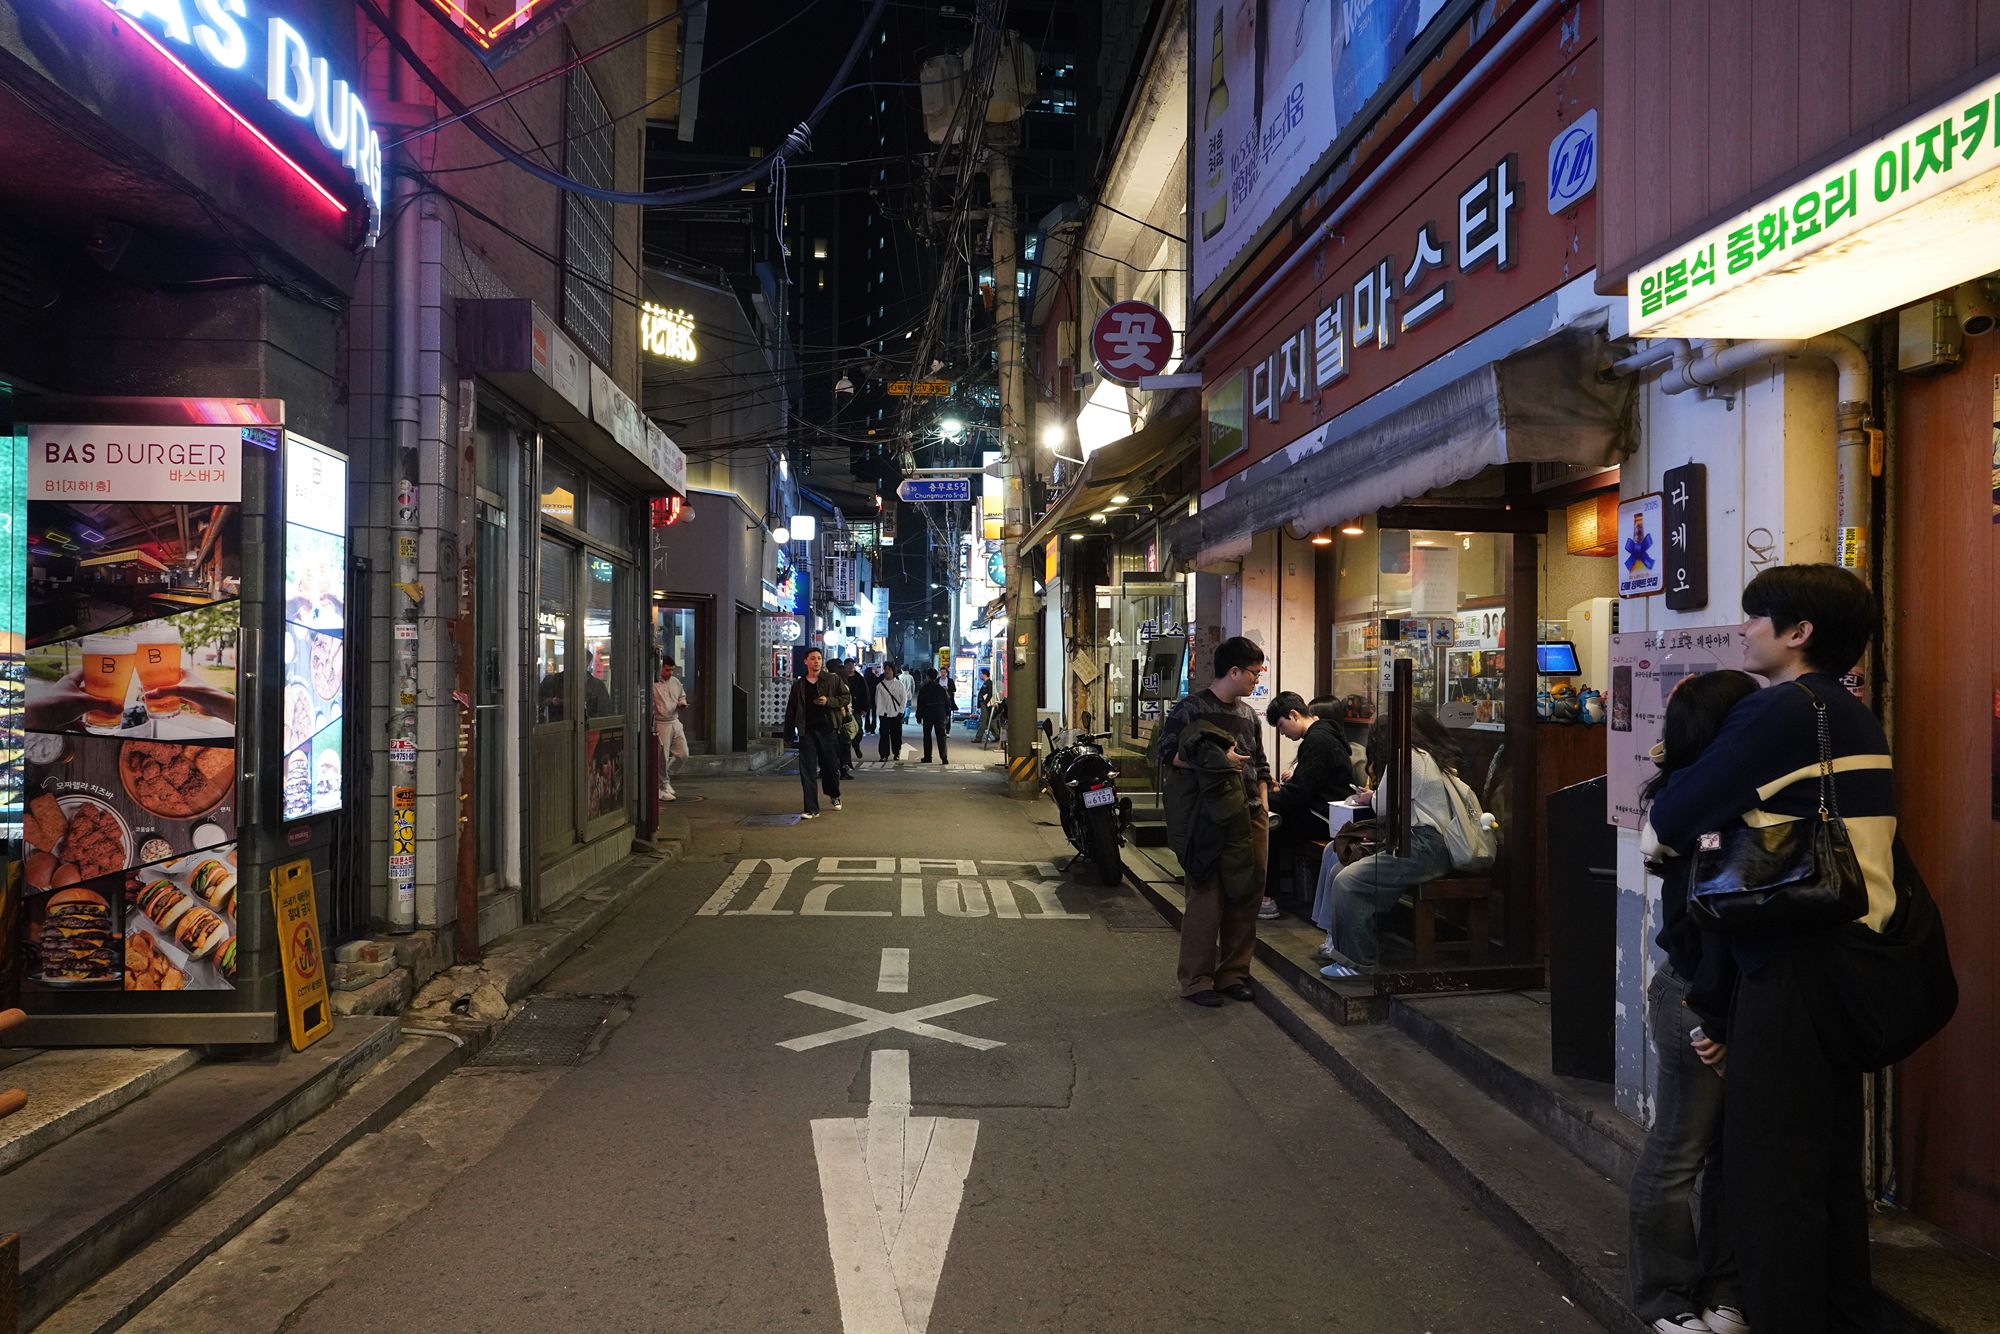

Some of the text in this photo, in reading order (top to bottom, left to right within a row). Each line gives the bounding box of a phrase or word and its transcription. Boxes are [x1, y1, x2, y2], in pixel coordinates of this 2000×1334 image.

[1261, 80, 1305, 166] 부드러움
[1640, 243, 1716, 318] 일본식
[1727, 168, 1858, 276] 중화요리
[1252, 159, 1516, 424] 디지털마스타
[1102, 311, 1163, 371] 꽃
[45, 442, 226, 465] BAS BURGER
[169, 469, 226, 483] 바스버거
[45, 479, 112, 493] B1[지하1층]
[928, 482, 968, 492] 충무로5길
[1643, 501, 1659, 512] 2025
[1671, 481, 1690, 594] 다케오
[1620, 580, 1631, 591] 더블
[1647, 576, 1659, 588] 맛집
[56, 781, 115, 800] 모짜렐라 치즈바
[1092, 793, 1112, 805] 6157
[695, 857, 1091, 920] 진입금지
[288, 903, 312, 922] 절대 금지
[297, 983, 311, 998] CCTV
